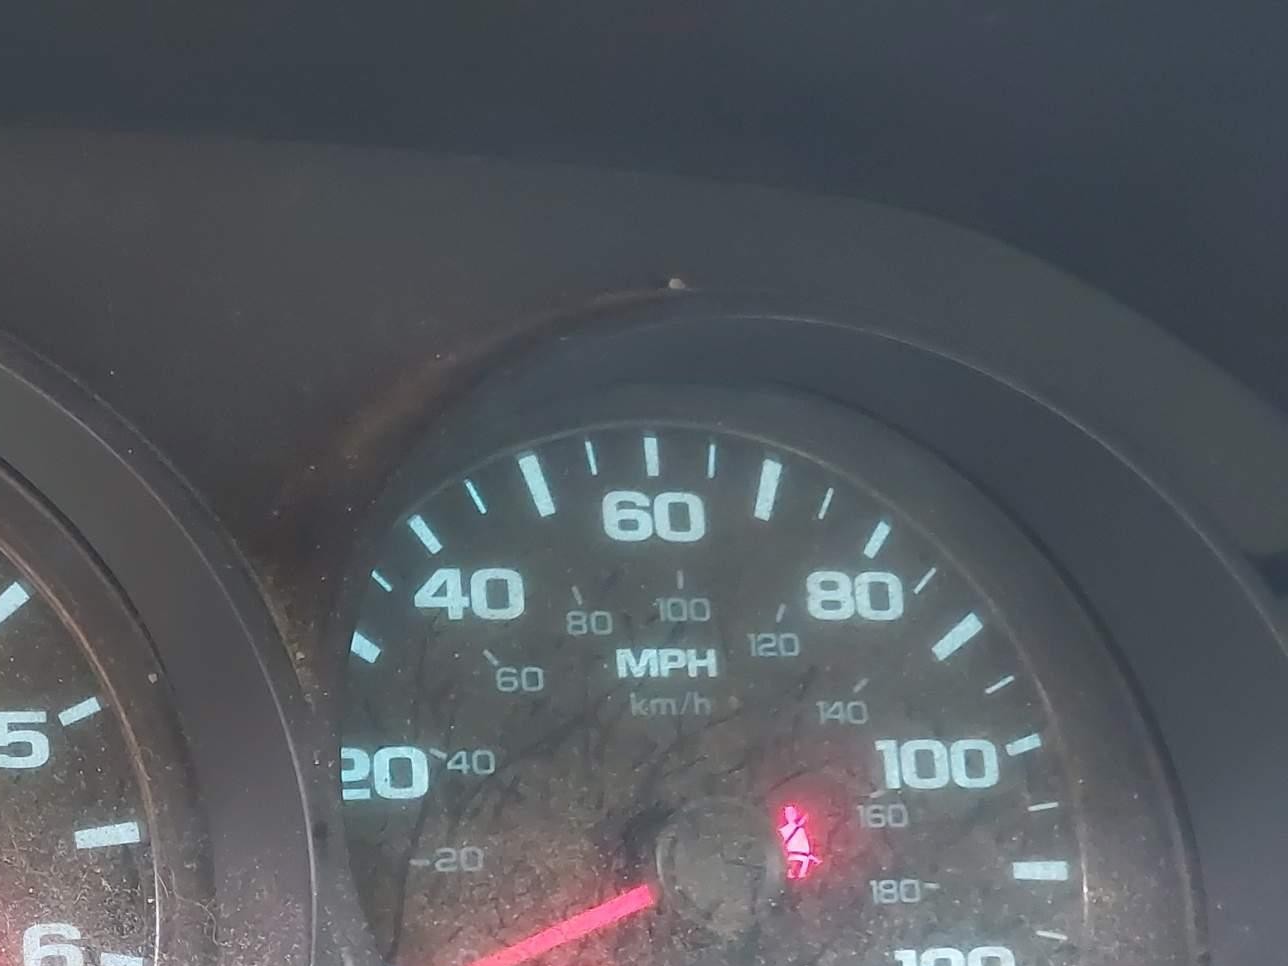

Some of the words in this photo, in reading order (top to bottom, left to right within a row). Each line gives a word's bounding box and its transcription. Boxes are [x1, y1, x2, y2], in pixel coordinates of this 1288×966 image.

[601, 490, 706, 542] 60
[414, 567, 526, 620] 40
[806, 571, 904, 621] 80
[656, 597, 711, 622] 100
[566, 610, 612, 636] 80
[747, 632, 800, 657] 120
[615, 648, 717, 678] MPH
[496, 666, 545, 692] 60
[629, 692, 712, 716] km/h
[816, 700, 869, 725] 140
[340, 746, 430, 801] 20
[447, 749, 496, 775] 40
[875, 739, 1000, 789] 100
[858, 803, 910, 829] 160
[434, 847, 485, 873] 20
[869, 879, 921, 904] 180
